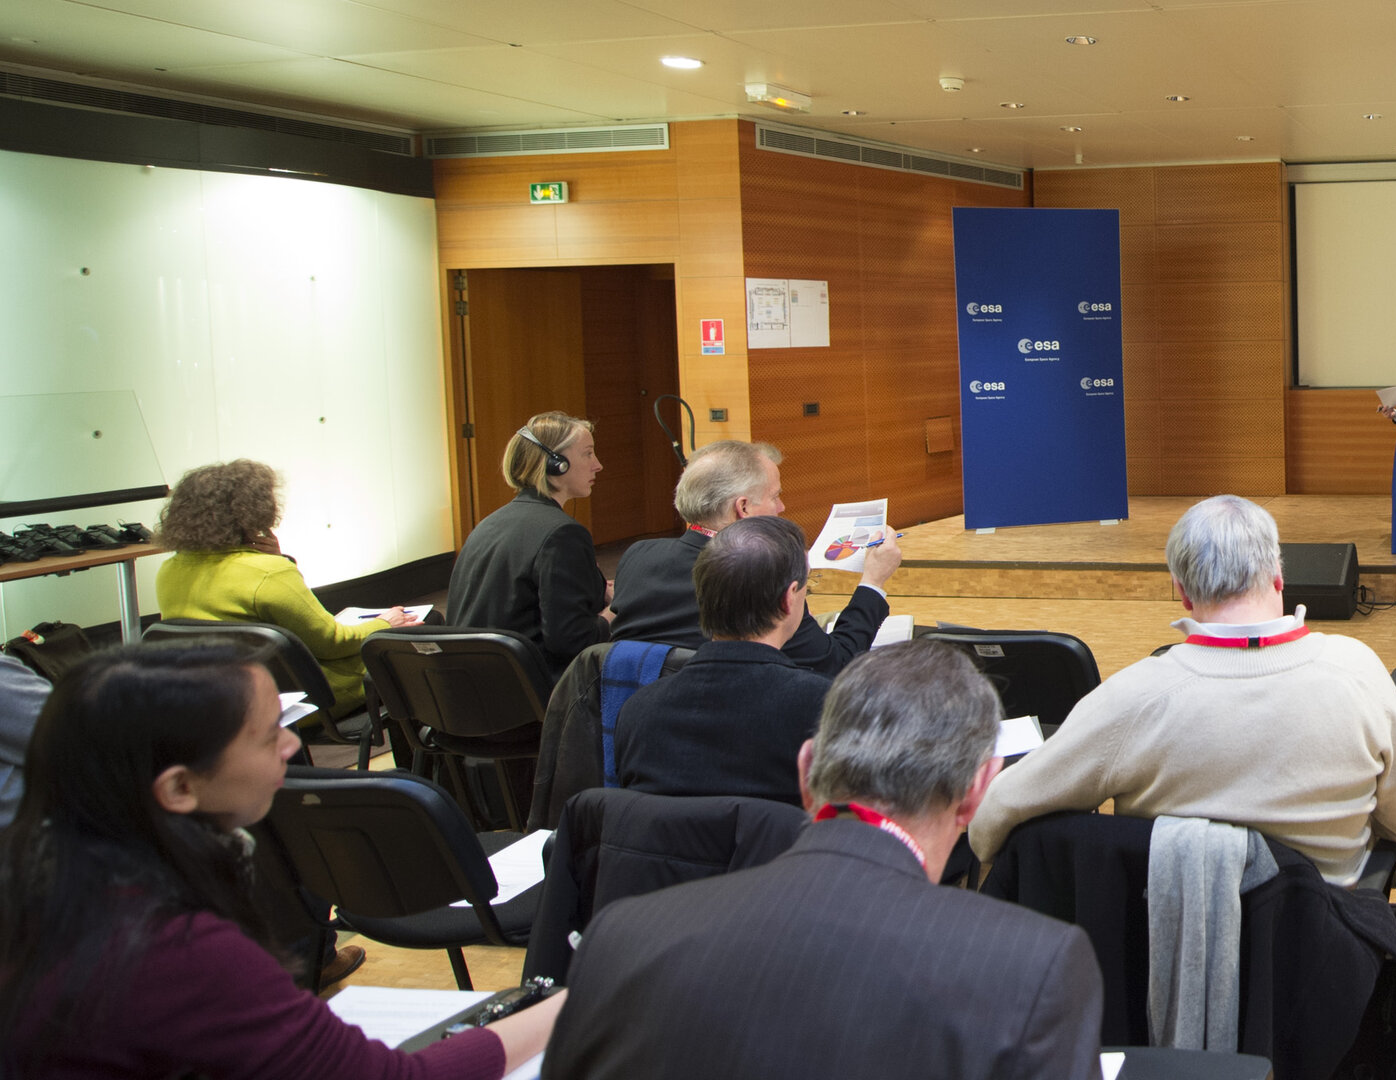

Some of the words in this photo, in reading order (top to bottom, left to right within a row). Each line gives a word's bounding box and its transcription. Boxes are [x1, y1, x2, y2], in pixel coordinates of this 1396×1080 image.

[980, 304, 1003, 313] esa
[1091, 303, 1112, 312] esa
[1034, 340, 1060, 351] esa
[983, 382, 1006, 391] esa
[1093, 378, 1114, 387] esa
